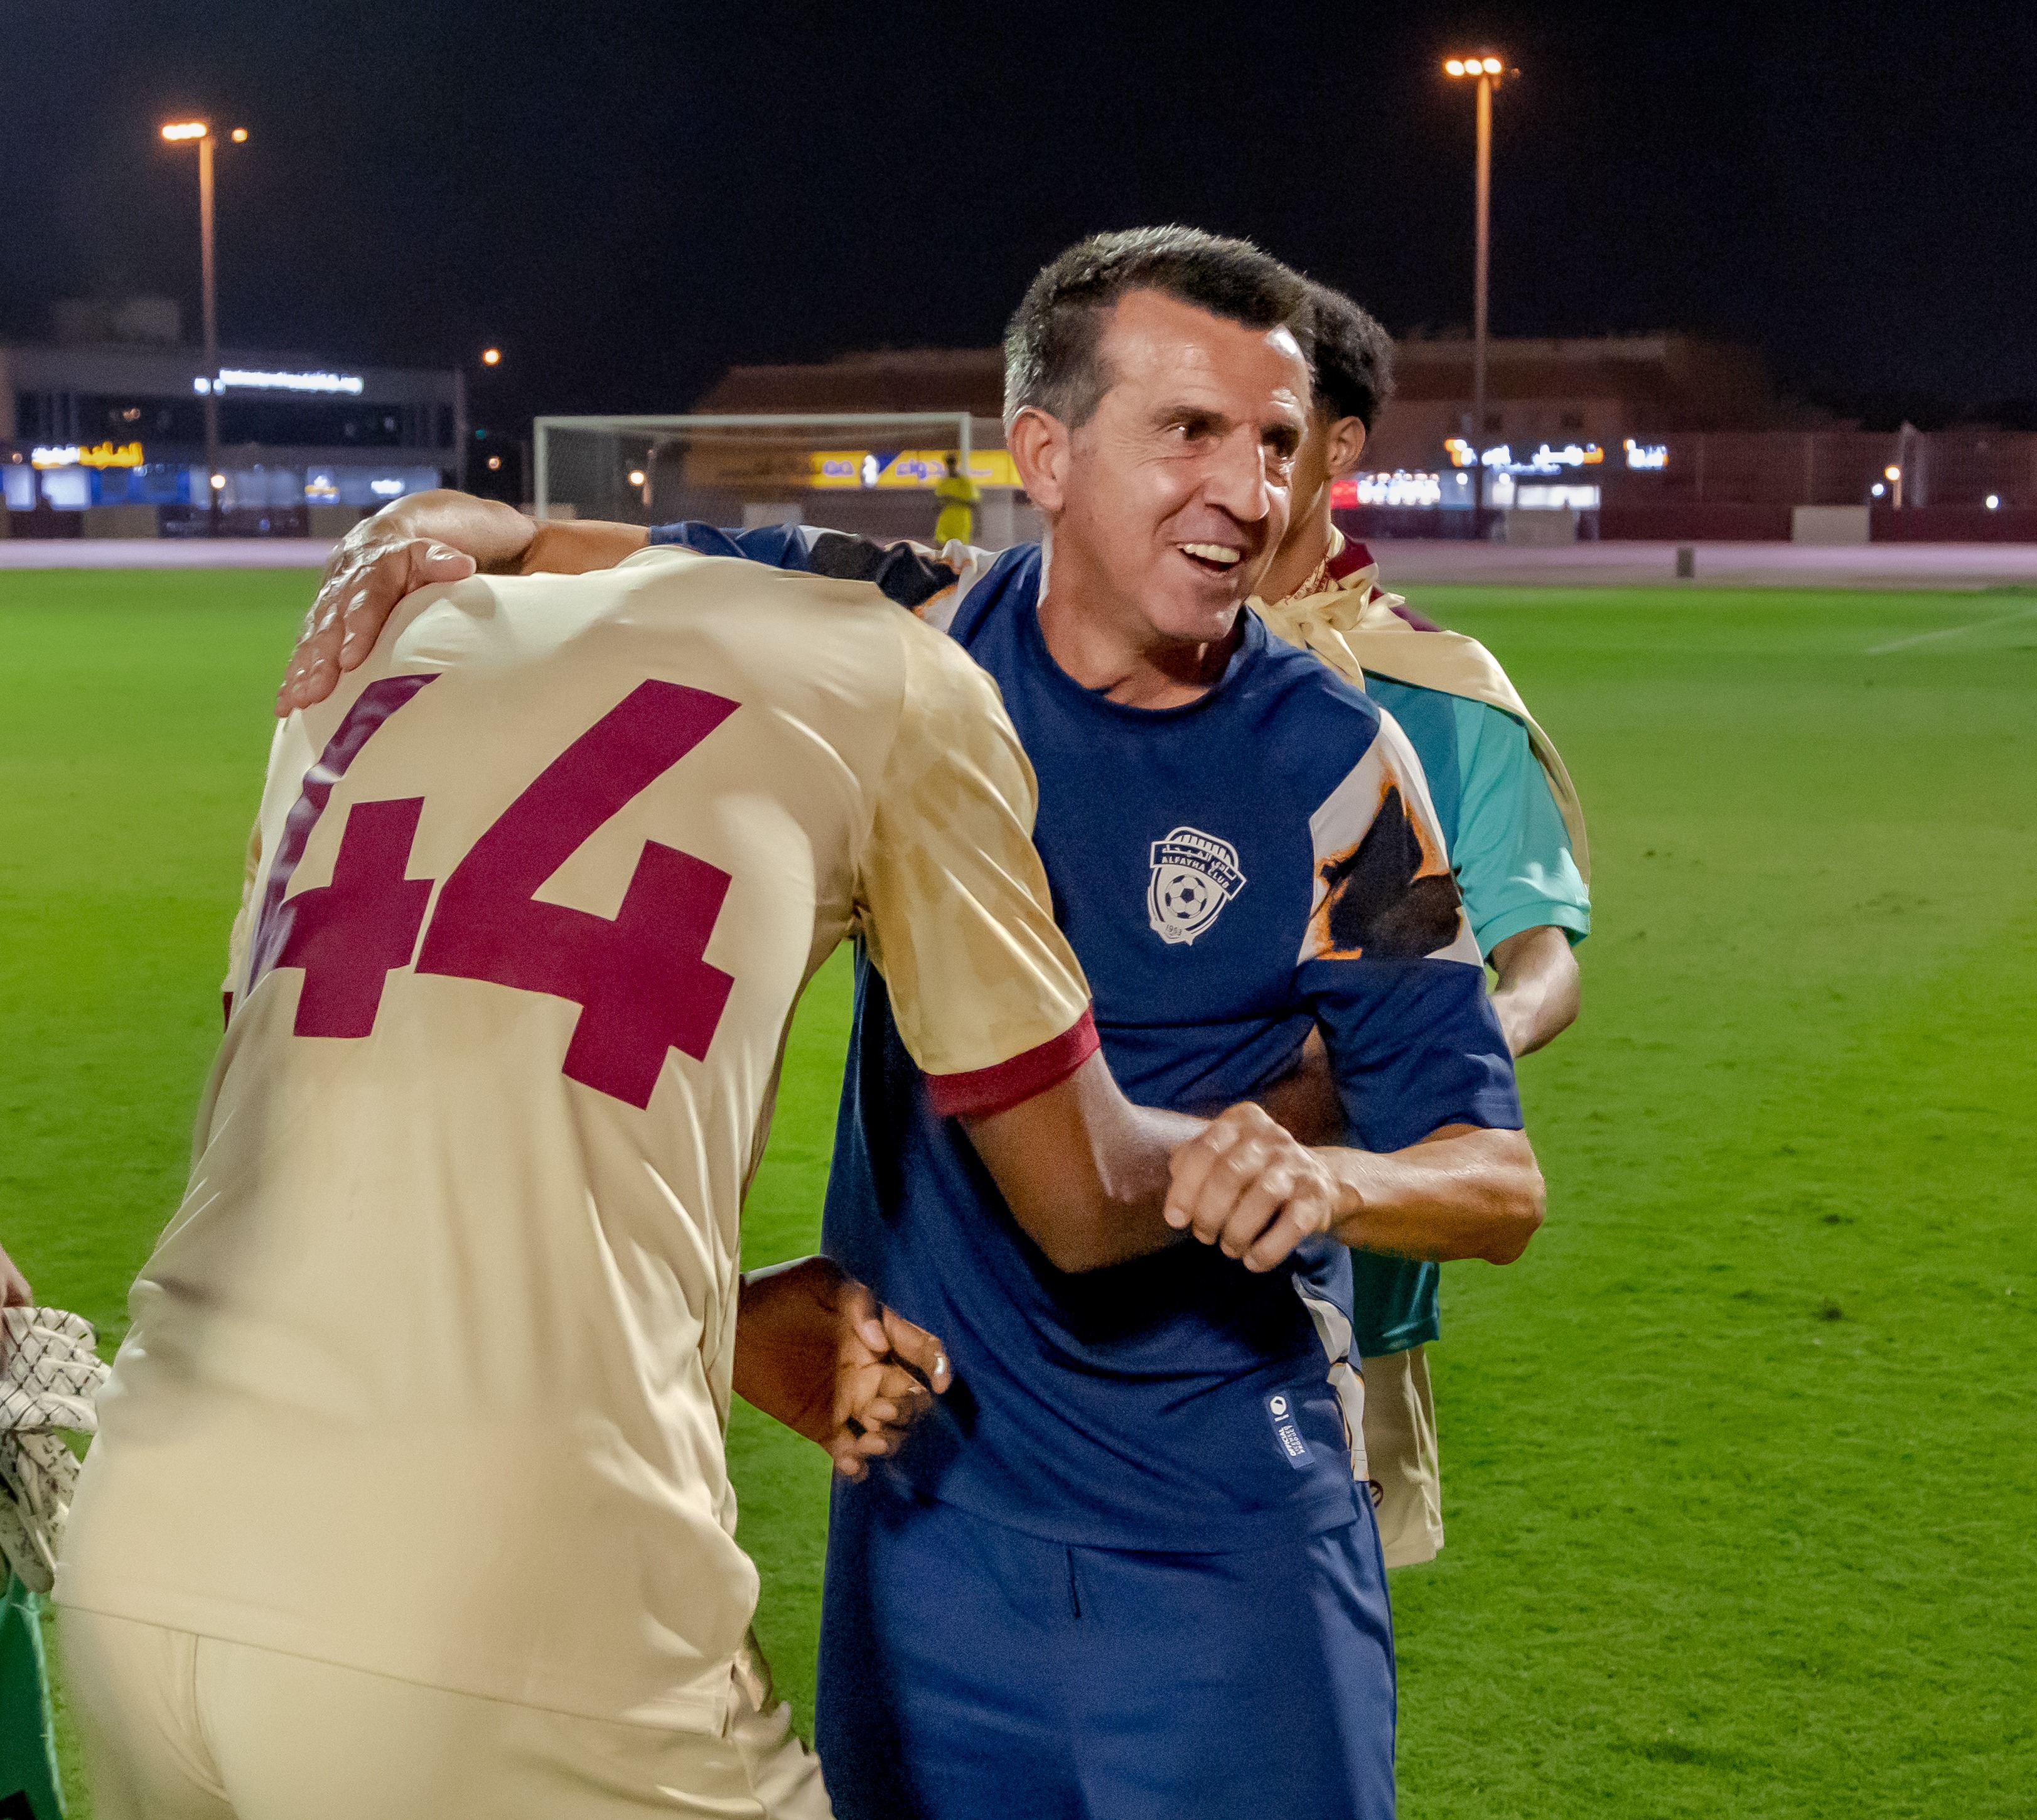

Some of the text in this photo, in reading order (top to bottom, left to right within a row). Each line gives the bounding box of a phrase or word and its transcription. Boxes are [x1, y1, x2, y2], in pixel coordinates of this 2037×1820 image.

[1161, 856, 1230, 888] ALFAYHA CLUB
[252, 673, 742, 1111] 44
[1279, 1427, 1297, 1457] OFFICIAL
